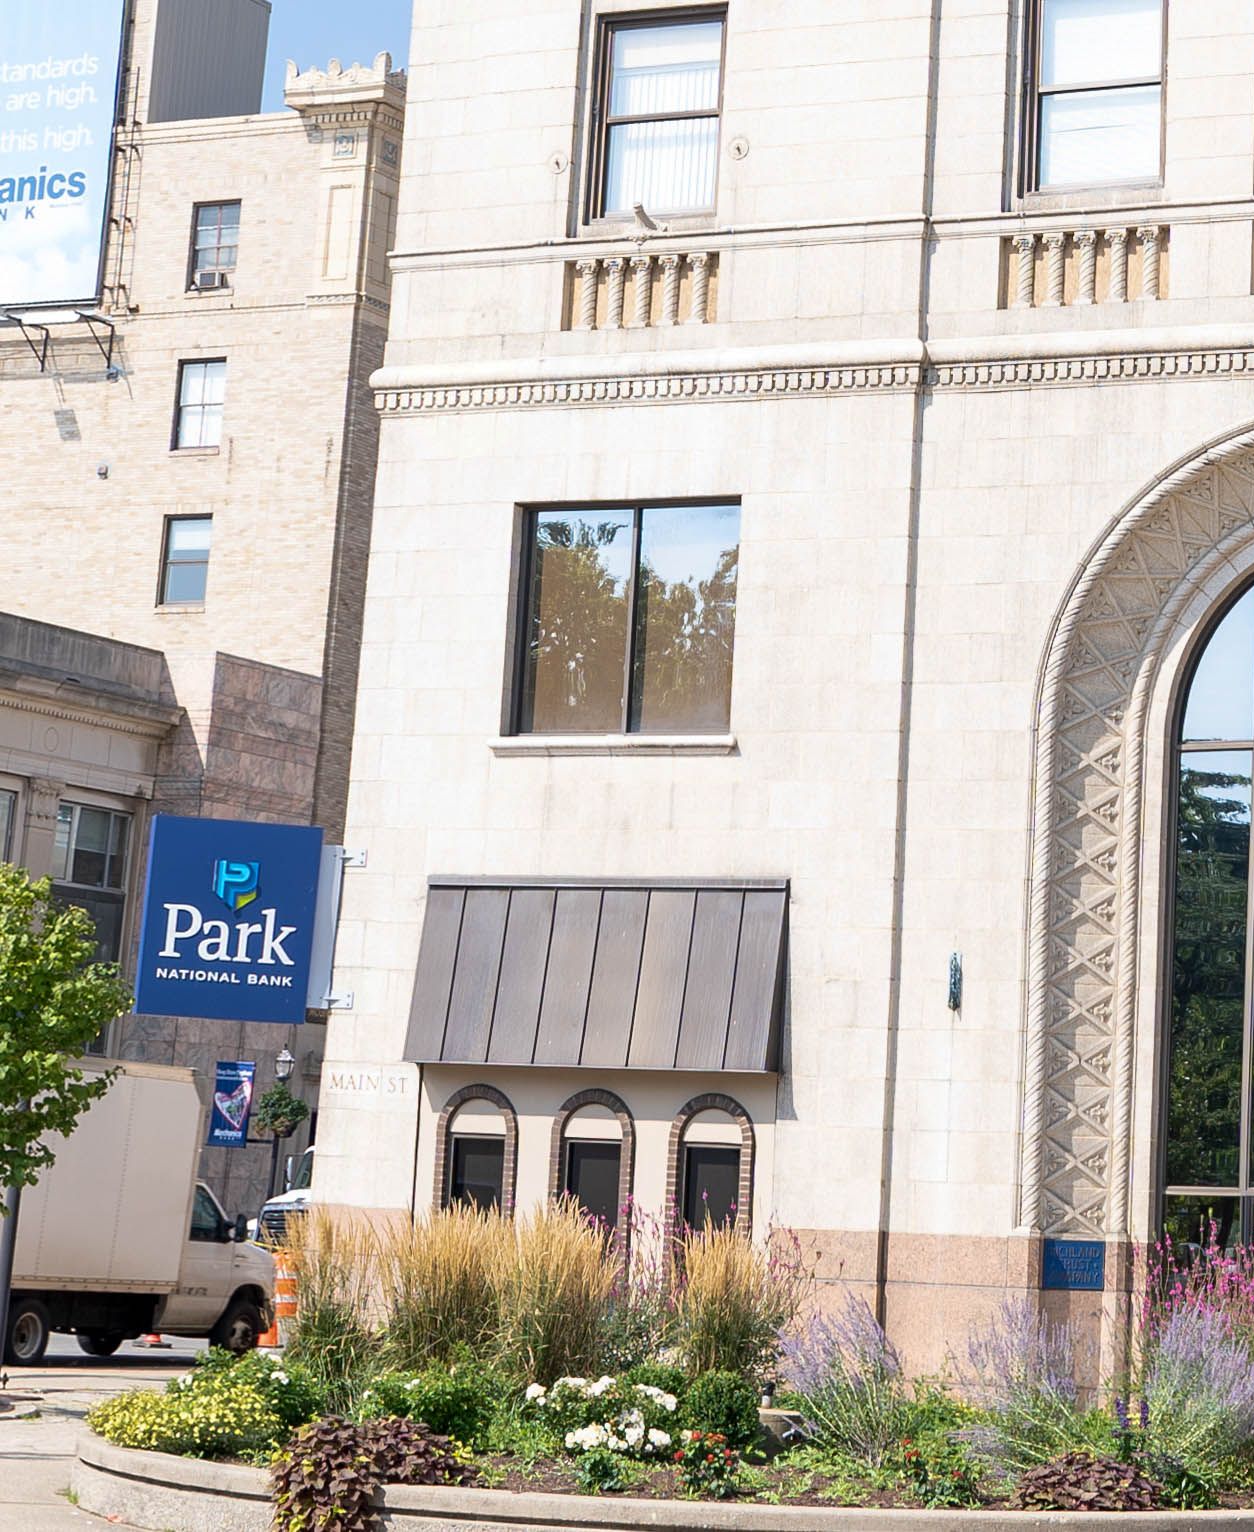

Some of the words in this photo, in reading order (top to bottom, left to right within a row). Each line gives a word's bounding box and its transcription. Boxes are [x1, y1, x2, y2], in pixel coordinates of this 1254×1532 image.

[6, 91, 40, 111] are
[158, 903, 297, 965] Park
[156, 968, 240, 983] NATIONAL
[247, 974, 292, 987] BANK
[328, 1072, 380, 1091] MAIN
[387, 1076, 409, 1095] ST
